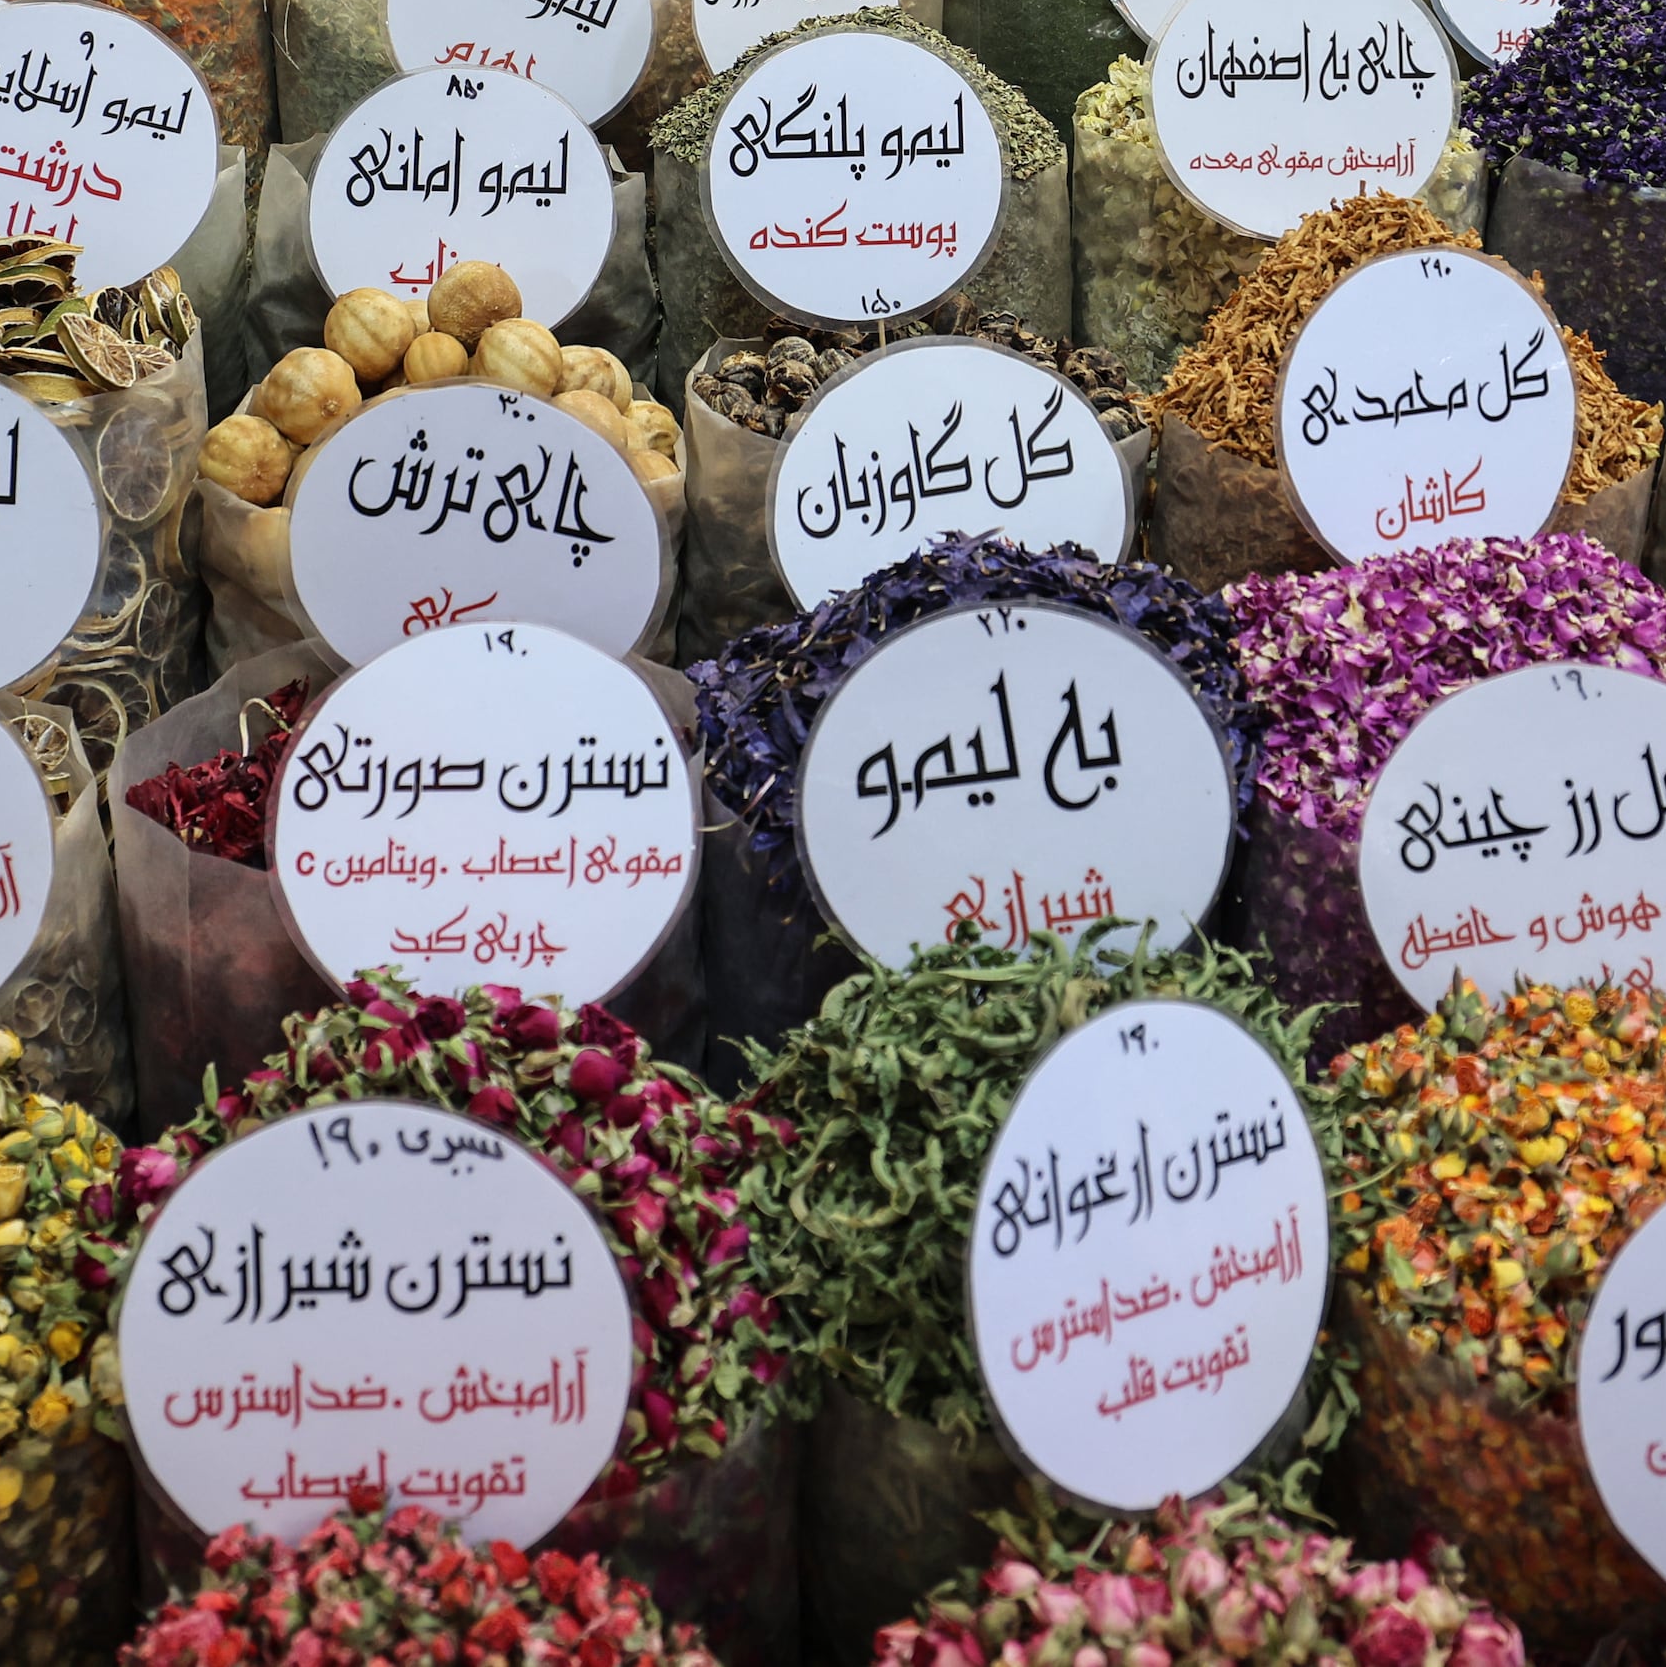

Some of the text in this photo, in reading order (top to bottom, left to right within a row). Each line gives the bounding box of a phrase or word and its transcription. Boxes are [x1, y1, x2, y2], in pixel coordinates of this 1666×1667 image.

[1177, 20, 1436, 101] چای به اصفهان
[101, 87, 193, 140] لیمو
[729, 83, 966, 181] لیمو پلنگی
[346, 126, 570, 218] لیمو امانی
[1190, 139, 1415, 177] آرامبخش مقوی معده
[749, 199, 958, 260] پوست کنده
[1301, 327, 1549, 446] گل محمدی
[985, 383, 1074, 509] گل
[348, 429, 615, 568] چای ترش
[1376, 455, 1486, 541] کاشان
[293, 723, 670, 820] نسترن صورتی
[856, 668, 1122, 841] به لیمو
[1396, 781, 1550, 873] چینی
[1565, 778, 1603, 859] رز
[461, 835, 681, 889] مقوی اعصاب
[390, 905, 567, 968] چربی کبد
[1401, 905, 1517, 970] حافظه
[1528, 914, 1549, 952] و
[1554, 890, 1661, 945] هوش
[990, 1097, 1287, 1257] نسترن ارغوانی
[157, 1223, 574, 1325] نسترن شیرازی
[1190, 1205, 1304, 1309] آرامبخش
[418, 1349, 589, 1425] آرامبخش
[1097, 1326, 1251, 1422] تقویت قلب
[397, 1456, 526, 1516] تقویت
